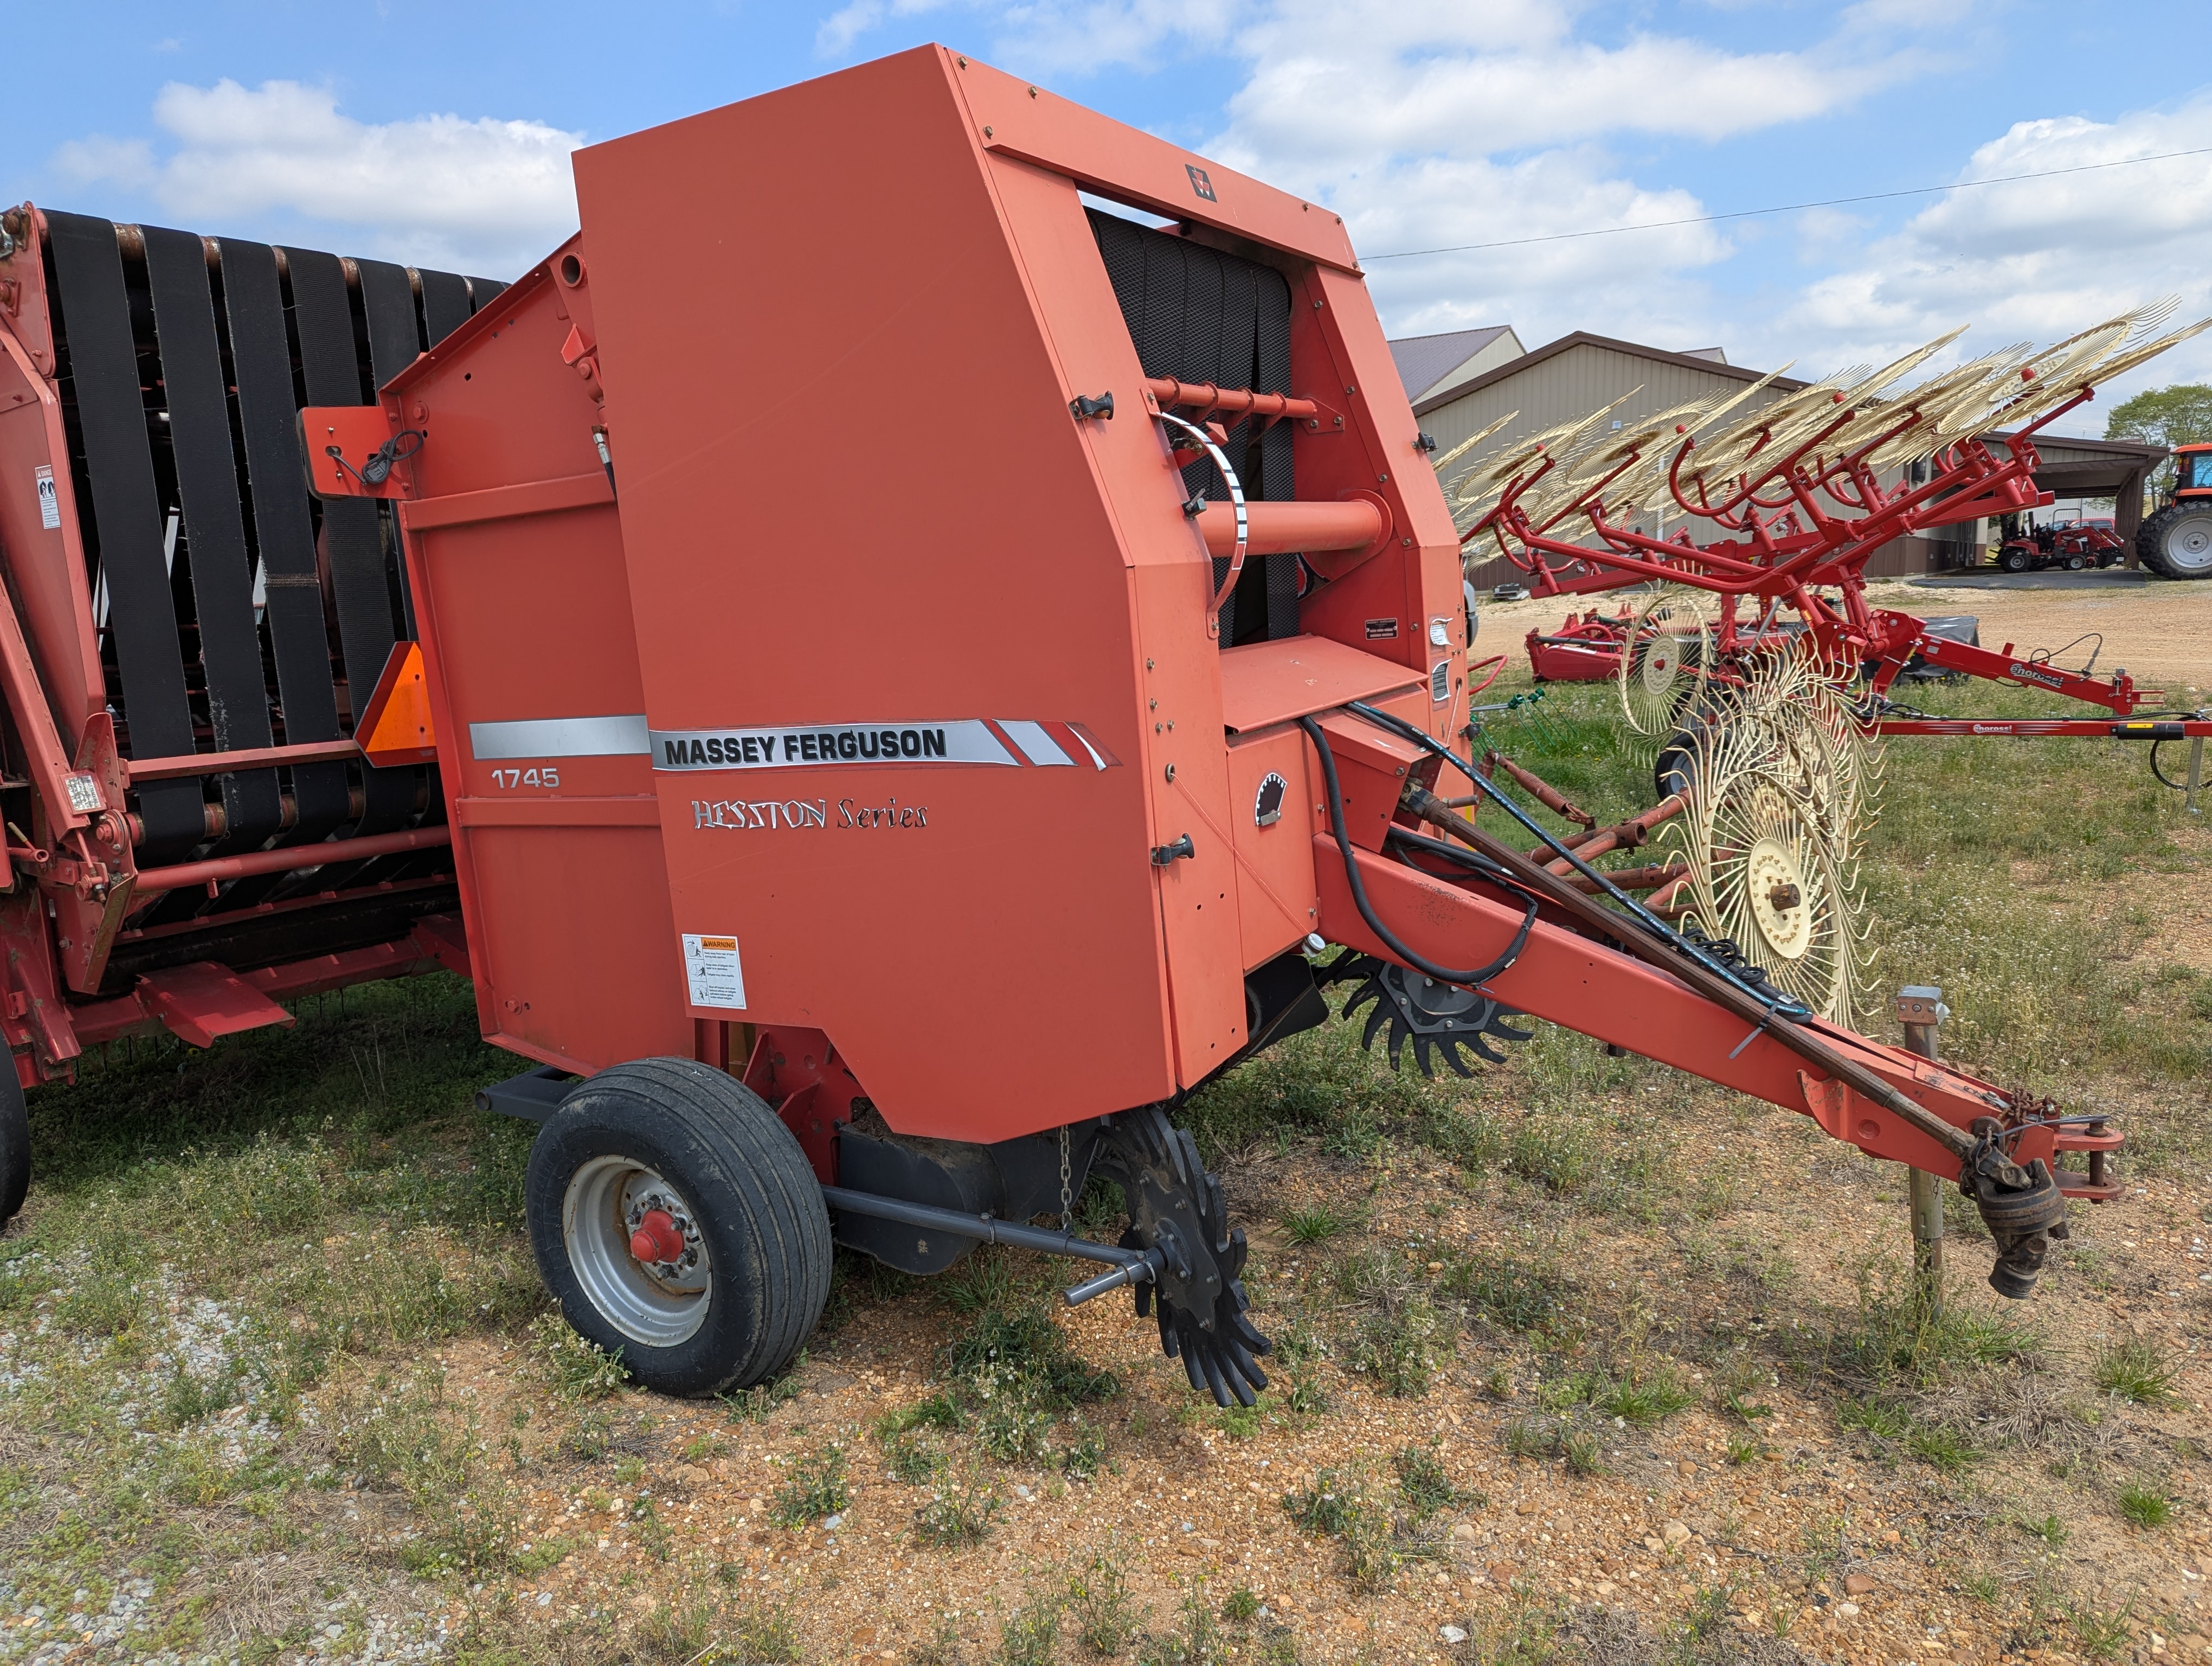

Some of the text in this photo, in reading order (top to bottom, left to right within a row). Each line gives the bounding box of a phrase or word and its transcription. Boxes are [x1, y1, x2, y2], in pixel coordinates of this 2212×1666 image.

[664, 729, 947, 765] MASSEY FERGUSON
[492, 767, 560, 789] 1745
[692, 797, 928, 829] HESSTON Series
